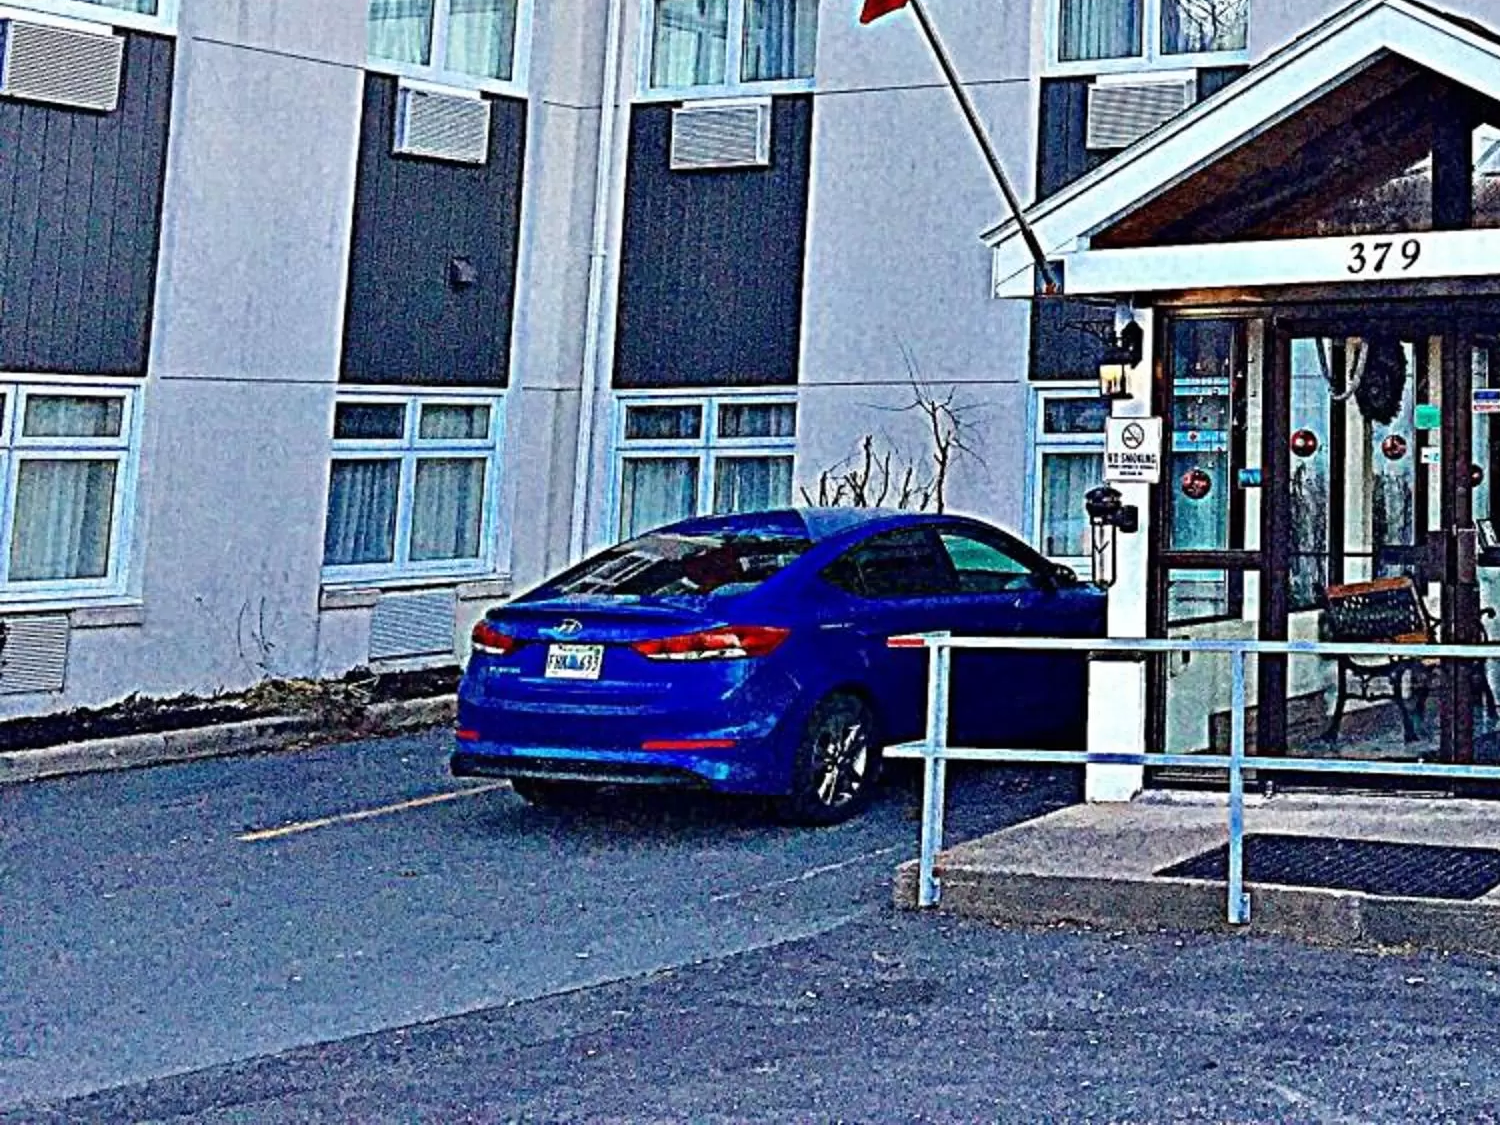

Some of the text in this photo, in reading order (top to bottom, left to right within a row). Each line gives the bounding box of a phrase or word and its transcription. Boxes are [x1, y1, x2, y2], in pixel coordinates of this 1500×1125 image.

[1347, 238, 1421, 274] 379
[1108, 452, 1156, 464] NO SMOKING
